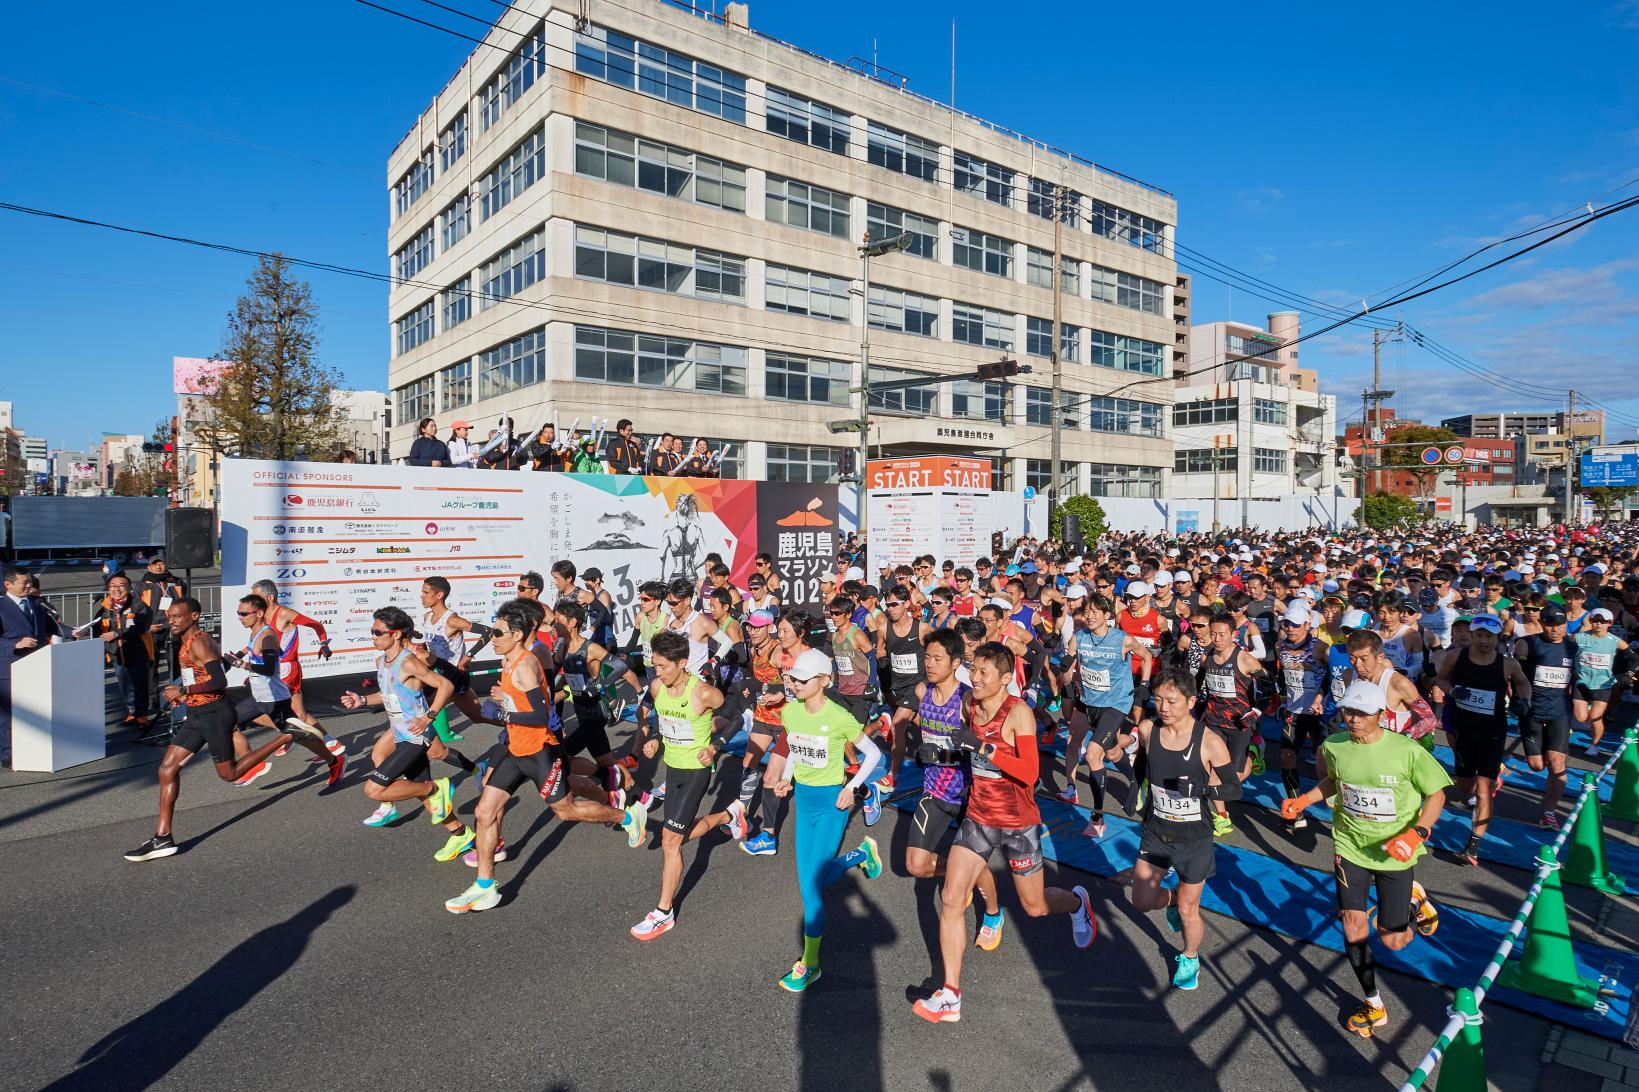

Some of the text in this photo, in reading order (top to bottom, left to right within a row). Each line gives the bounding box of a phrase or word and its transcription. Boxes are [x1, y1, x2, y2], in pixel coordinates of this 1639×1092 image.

[254, 472, 353, 481] OFFICIAL SPONSORS
[874, 470, 932, 489] START
[944, 470, 988, 488] START
[307, 498, 353, 507] 鹿児島銀行
[442, 501, 499, 510] JAグループ鹿児島
[778, 532, 833, 558] 鹿児島
[778, 559, 833, 577] マラソン
[780, 578, 820, 605] 202
[1088, 674, 1101, 682] 206
[790, 744, 827, 758] 志村美希
[1380, 775, 1400, 784] TEL
[1160, 798, 1190, 810] 1134
[1354, 795, 1378, 808] 254
